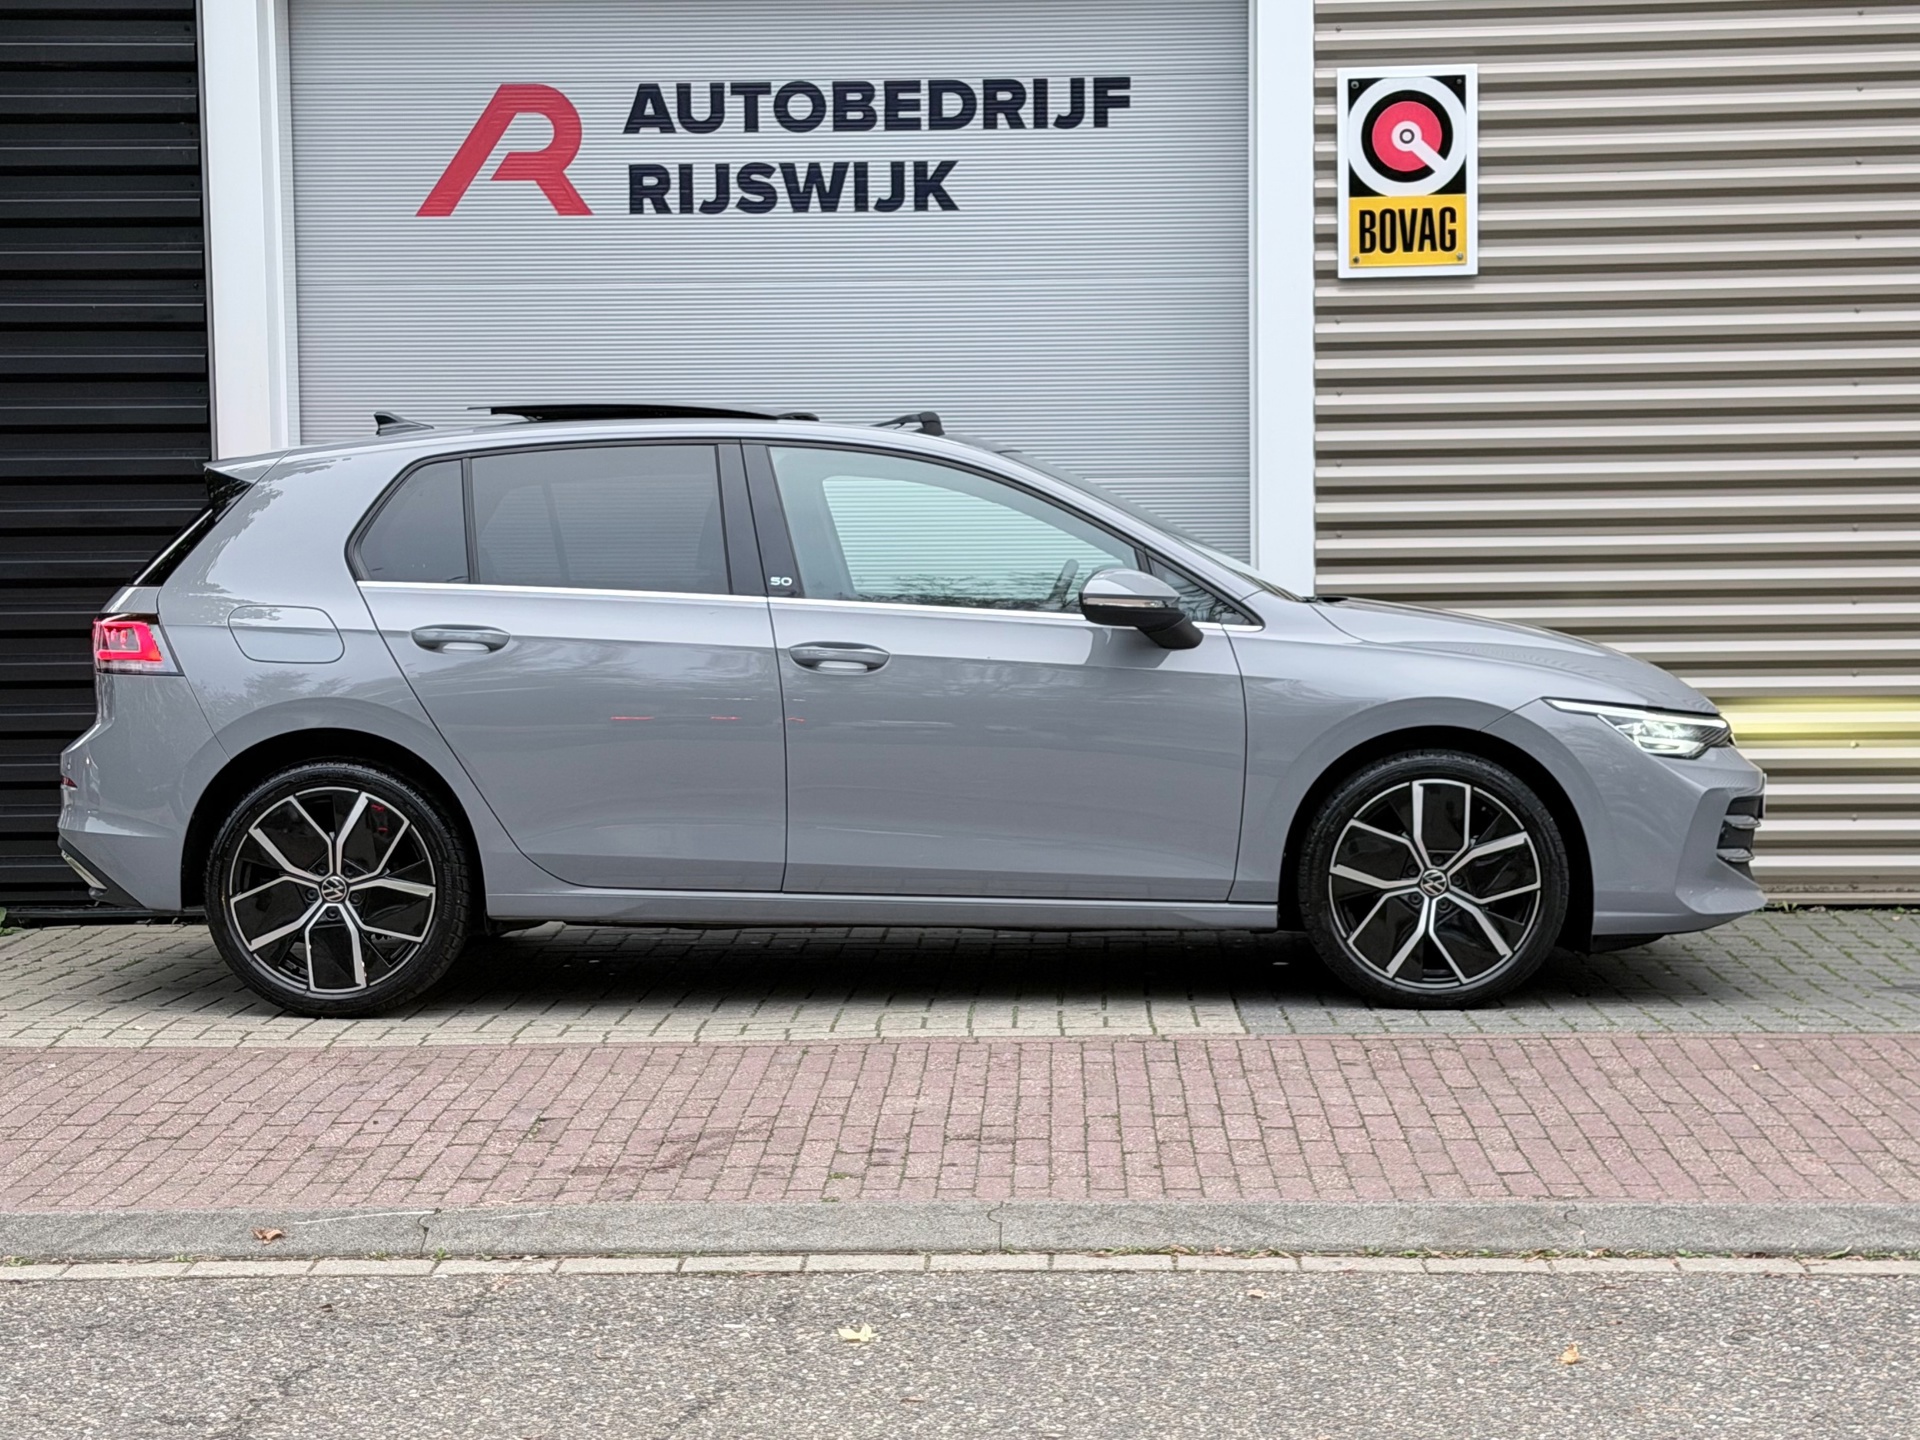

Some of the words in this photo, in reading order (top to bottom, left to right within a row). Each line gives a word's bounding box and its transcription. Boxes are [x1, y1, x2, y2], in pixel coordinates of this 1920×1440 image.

[623, 77, 1132, 134] AUTOBEDRIJF
[628, 161, 960, 215] RIJSWIJK
[1359, 206, 1457, 254] BOVAG
[770, 576, 793, 587] 50
